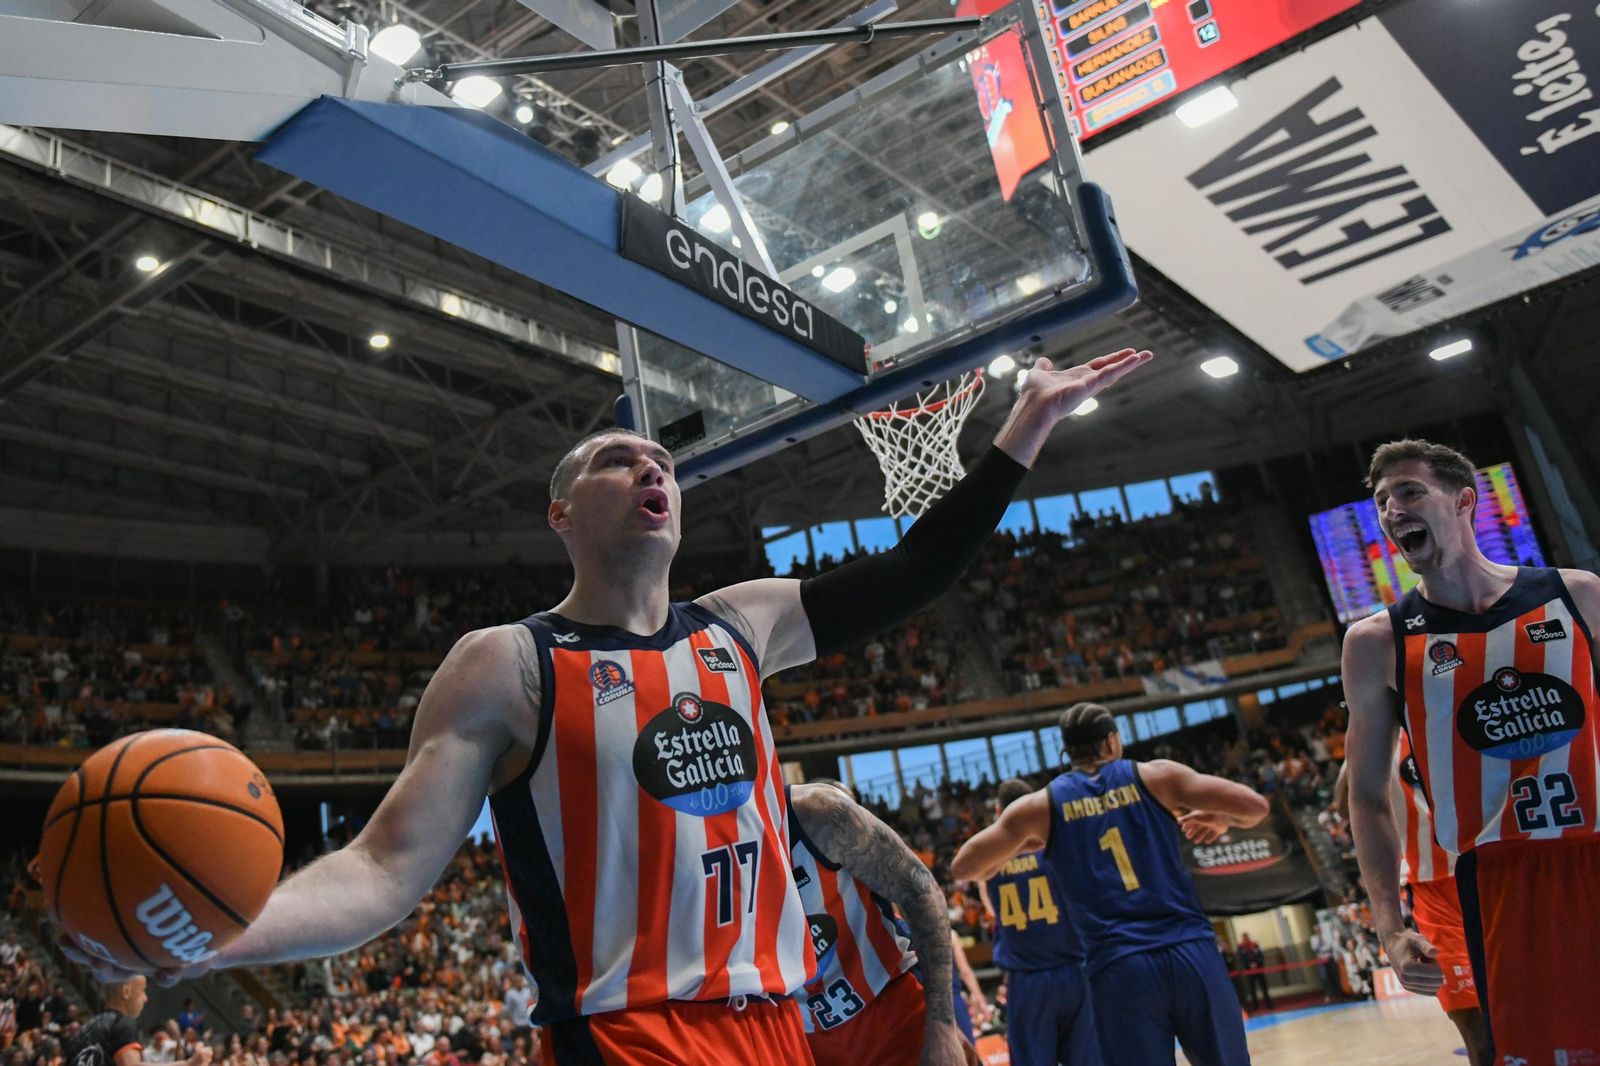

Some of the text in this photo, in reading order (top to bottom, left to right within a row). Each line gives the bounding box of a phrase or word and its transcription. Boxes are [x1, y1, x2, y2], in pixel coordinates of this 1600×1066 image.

[1511, 13, 1593, 122] leite,
[1185, 75, 1453, 286] LEYMA
[666, 229, 814, 340] endesa
[1474, 687, 1562, 722] Estrella
[1484, 707, 1566, 741] Galicia
[654, 721, 741, 760] Estrella
[666, 749, 744, 788] Galicia
[1062, 784, 1142, 822] ANDERSON
[1511, 772, 1585, 833] 22
[701, 841, 758, 926] 77
[1098, 826, 1140, 892] 1
[998, 876, 1059, 931] 44
[807, 977, 866, 1030] 23
